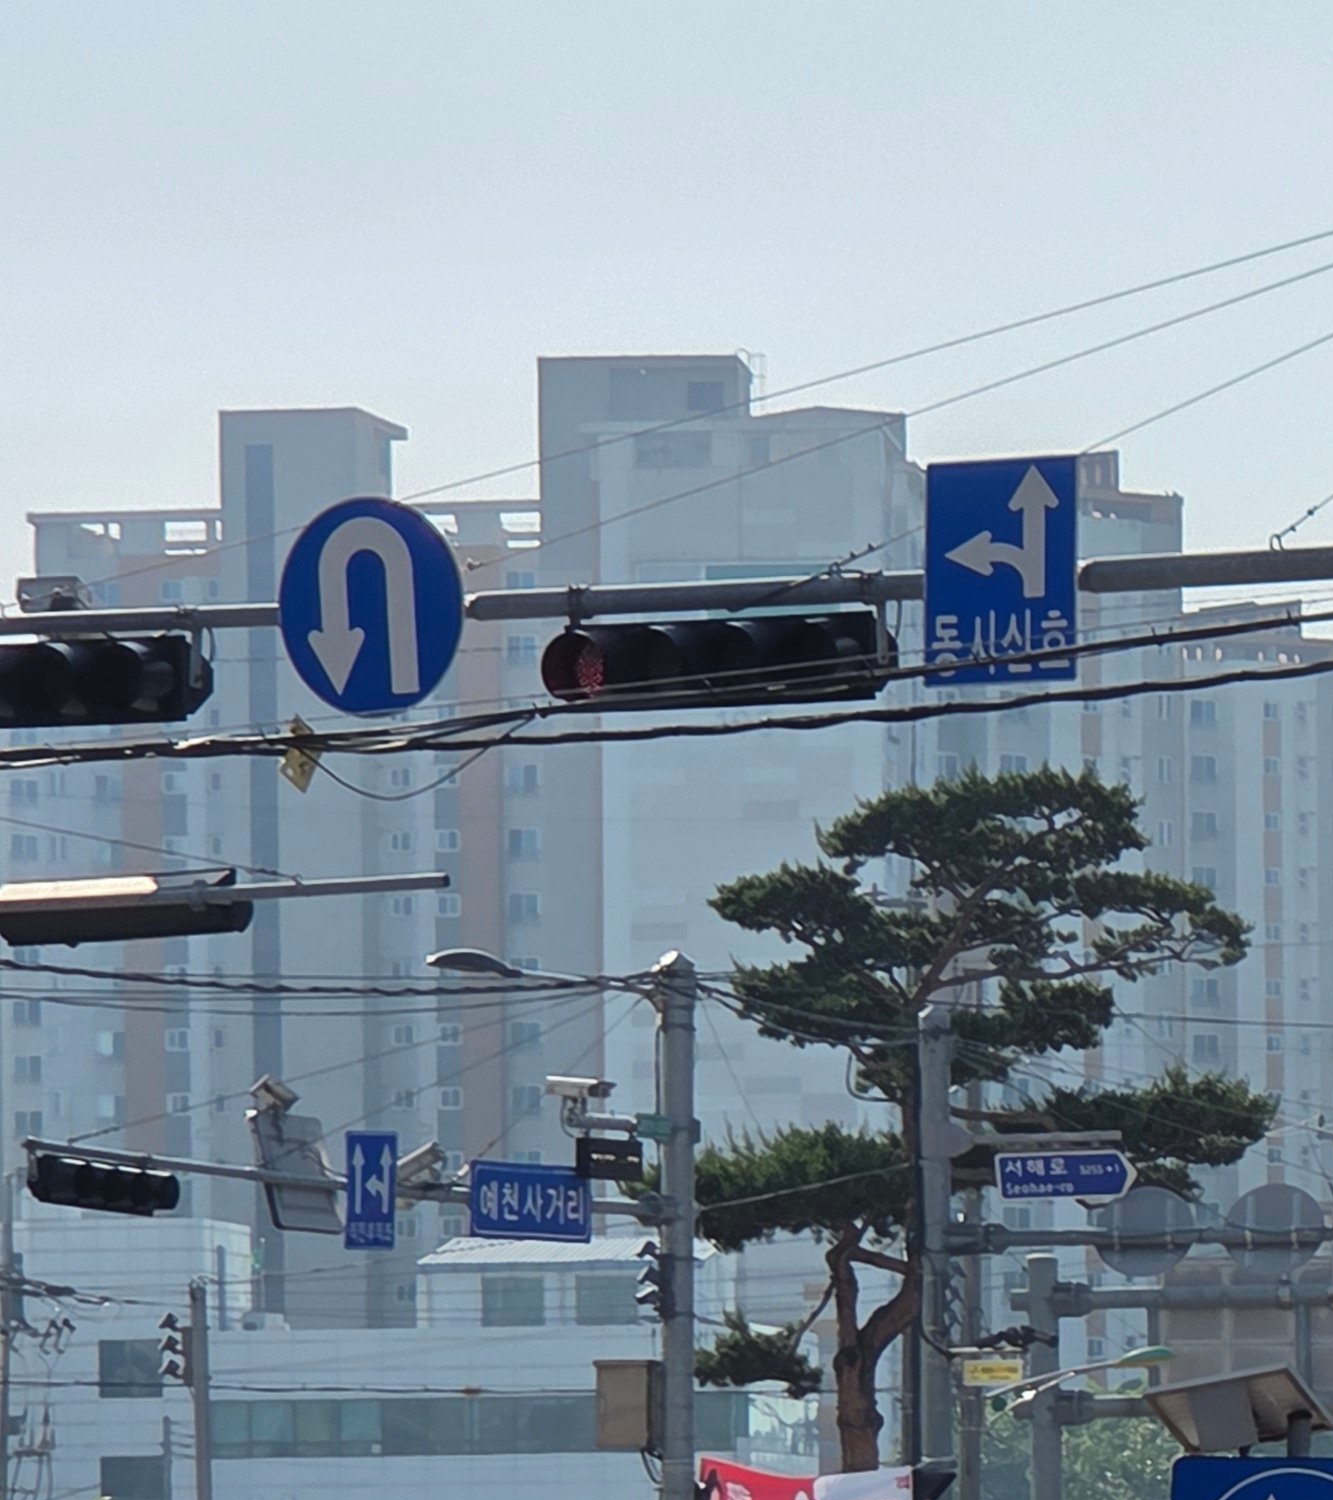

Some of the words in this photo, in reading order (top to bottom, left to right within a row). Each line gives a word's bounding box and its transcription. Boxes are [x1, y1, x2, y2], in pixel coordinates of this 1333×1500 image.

[931, 607, 1071, 678] 동시신호
[1004, 1157, 1068, 1178] 서해로
[479, 1180, 585, 1226] 예천사거리
